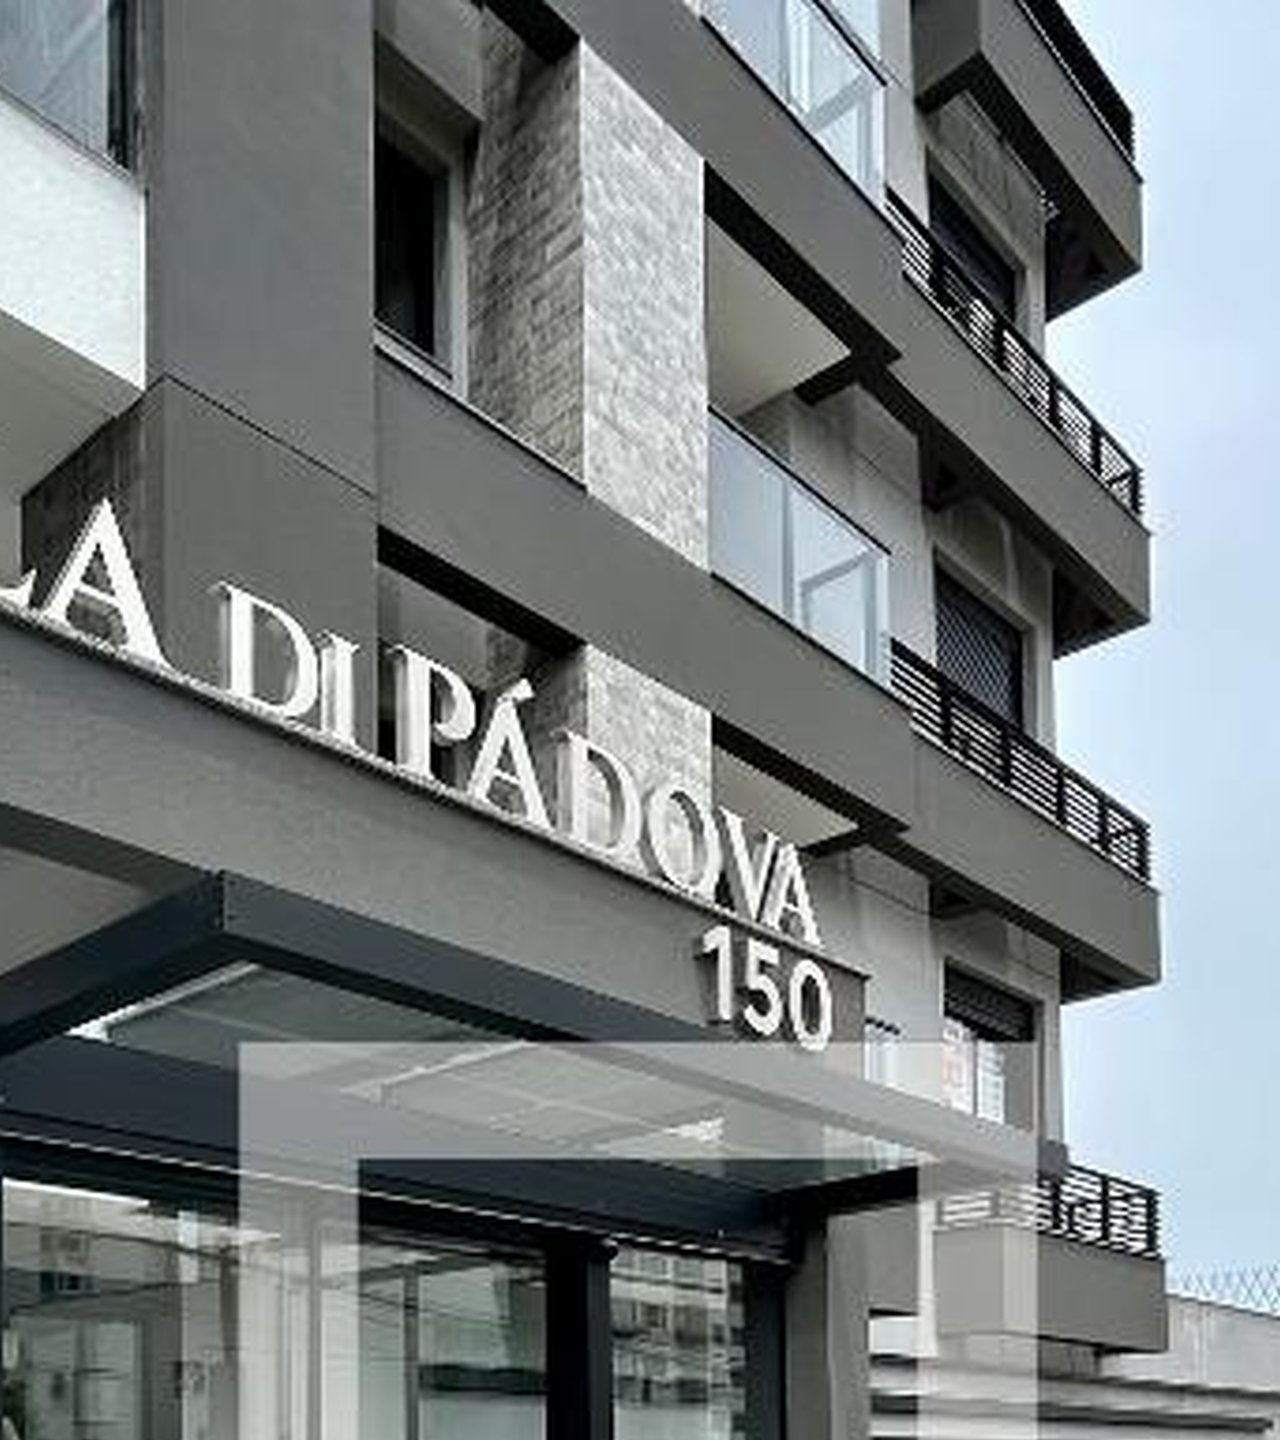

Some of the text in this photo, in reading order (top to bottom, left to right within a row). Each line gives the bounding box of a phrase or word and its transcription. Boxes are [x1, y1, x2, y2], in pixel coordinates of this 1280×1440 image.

[214, 580, 361, 754] DI
[386, 643, 824, 950] PÁDOVA
[700, 924, 832, 1051] 150
